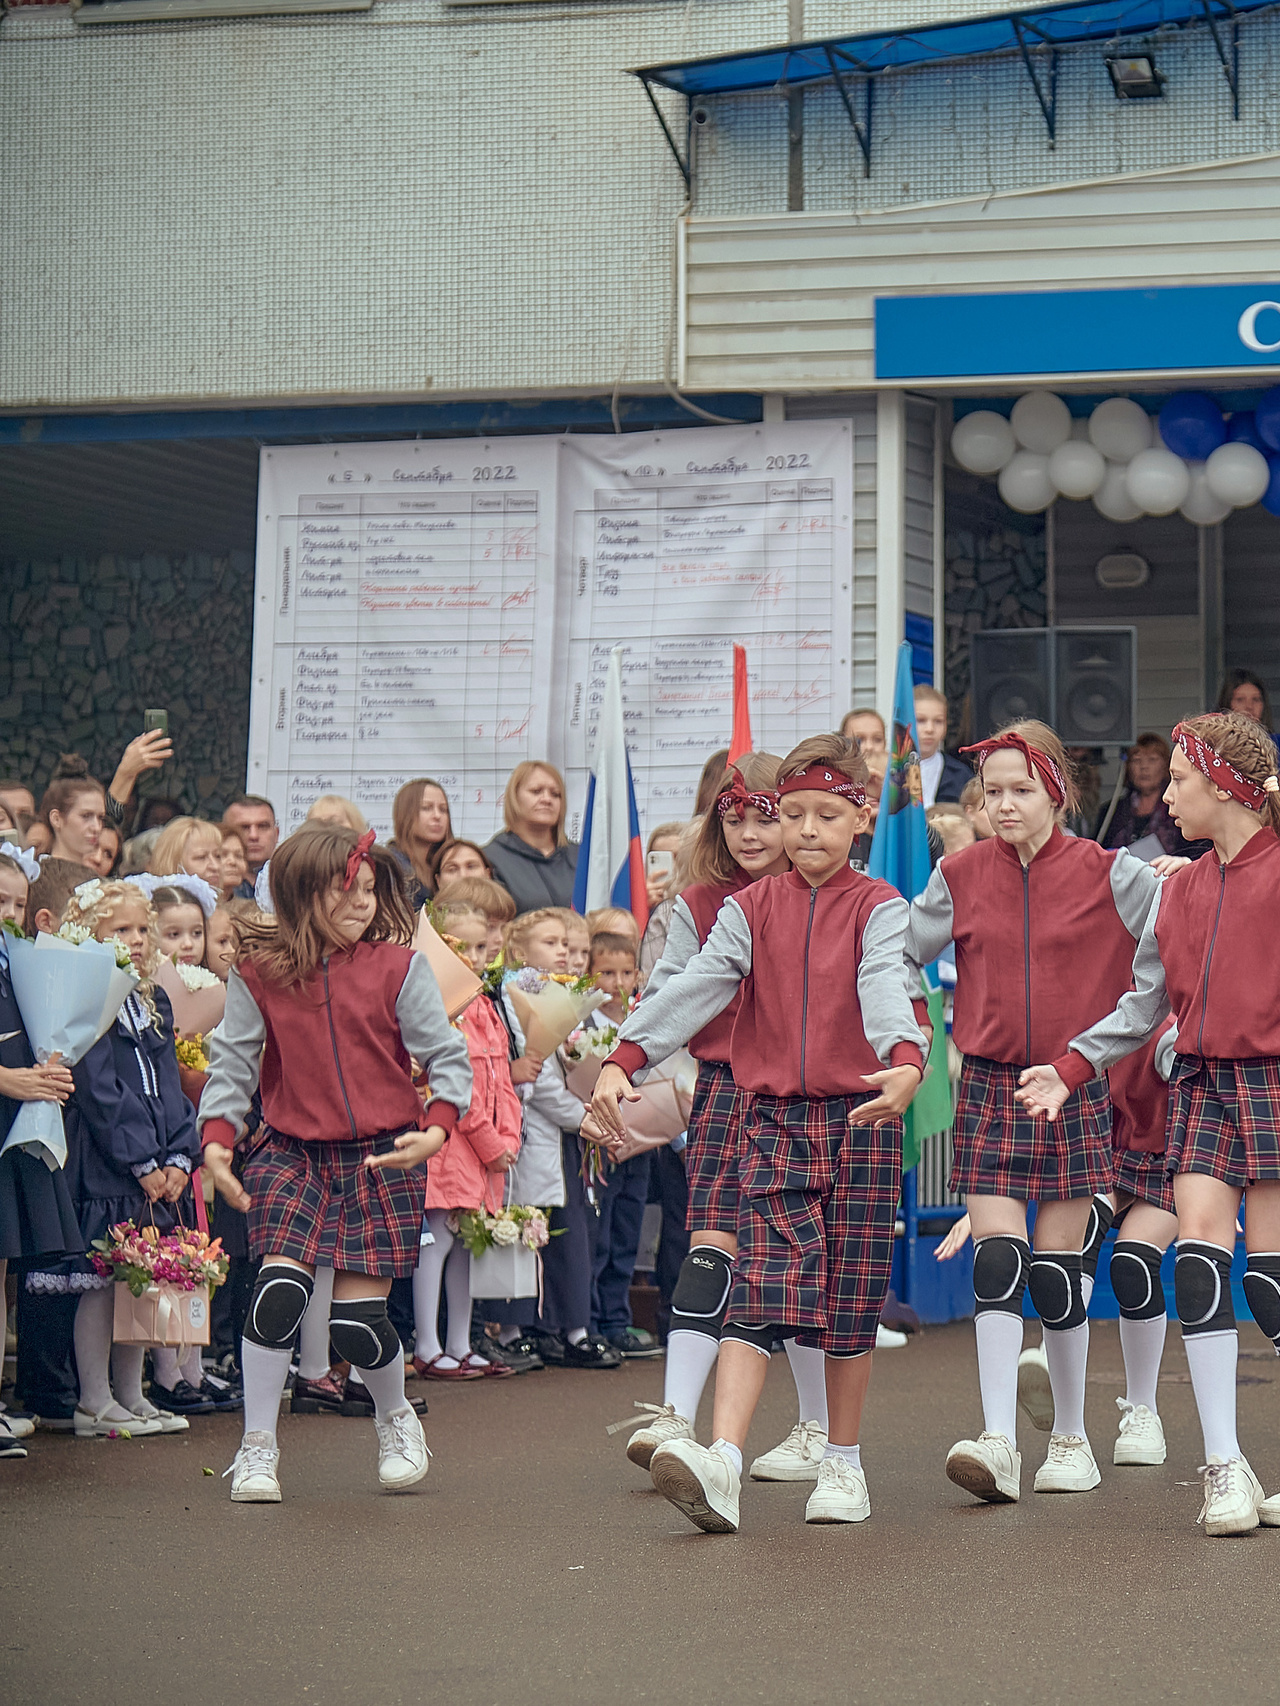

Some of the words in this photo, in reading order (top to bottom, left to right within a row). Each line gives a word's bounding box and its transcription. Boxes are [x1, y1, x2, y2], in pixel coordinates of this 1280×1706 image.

[765, 453, 812, 471] 2022
[472, 465, 517, 481] 2022
[280, 546, 291, 616] Понедельник
[577, 556, 587, 597] Четверг
[296, 646, 338, 662] Алгебра
[297, 664, 339, 679] Физика
[276, 687, 288, 731] Вторник
[570, 682, 582, 727] Пятница
[294, 726, 348, 742] География
[291, 774, 333, 792] Алгебра
